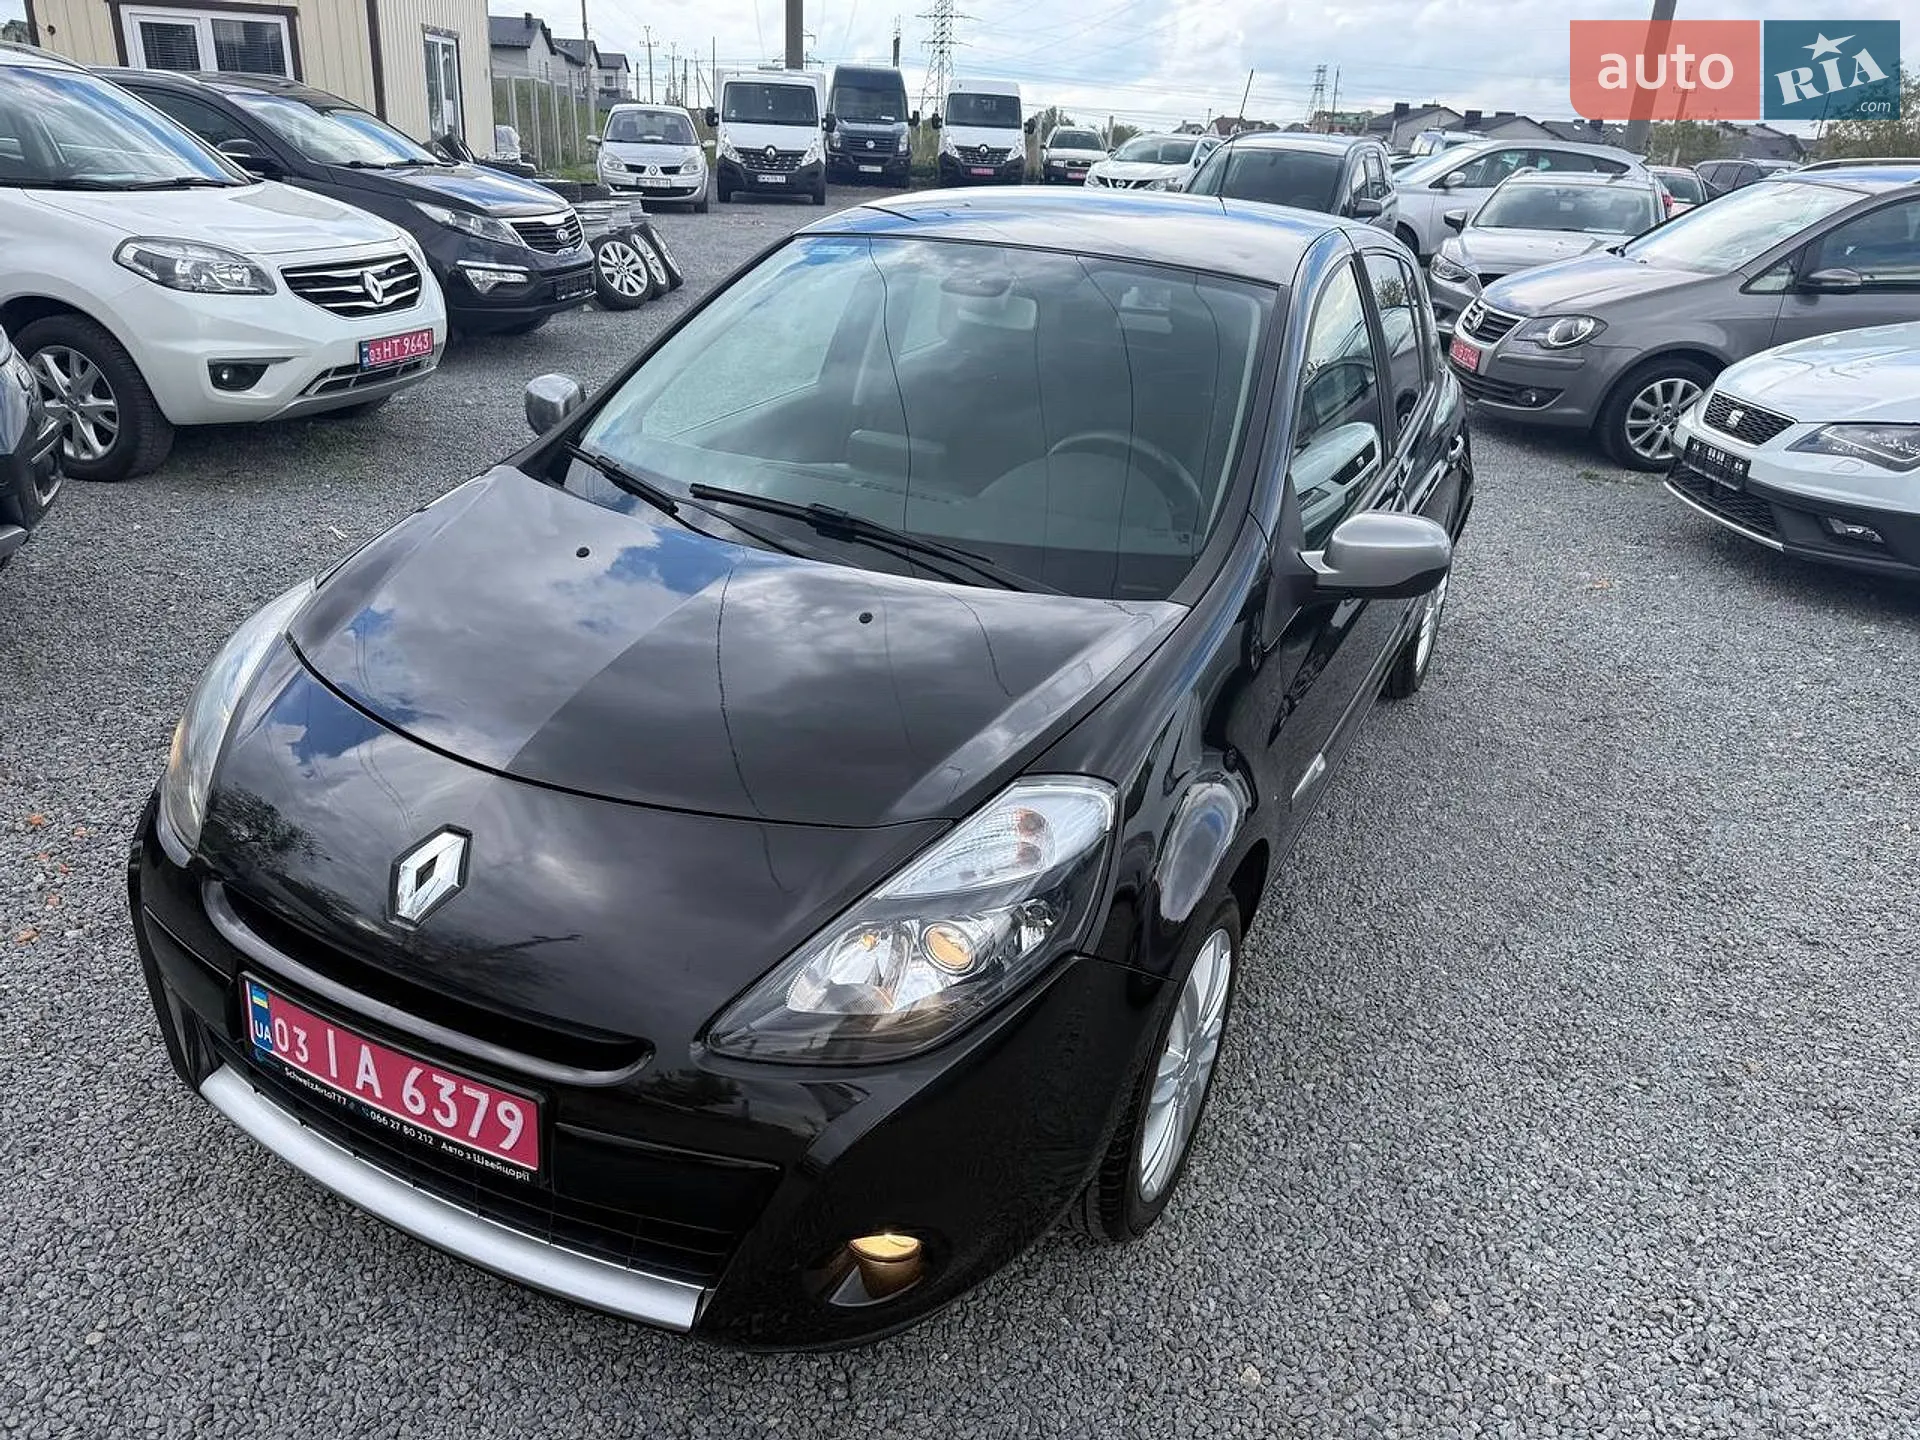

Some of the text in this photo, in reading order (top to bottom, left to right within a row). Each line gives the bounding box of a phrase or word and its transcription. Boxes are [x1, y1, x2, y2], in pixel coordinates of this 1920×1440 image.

[383, 340, 400, 358] HT
[403, 333, 429, 354] 9643
[254, 1020, 273, 1044] UA
[273, 1018, 524, 1151] 03 IA 6379
[370, 1111, 434, 1145] 066 27 80 212
[440, 1142, 464, 1157] Авто
